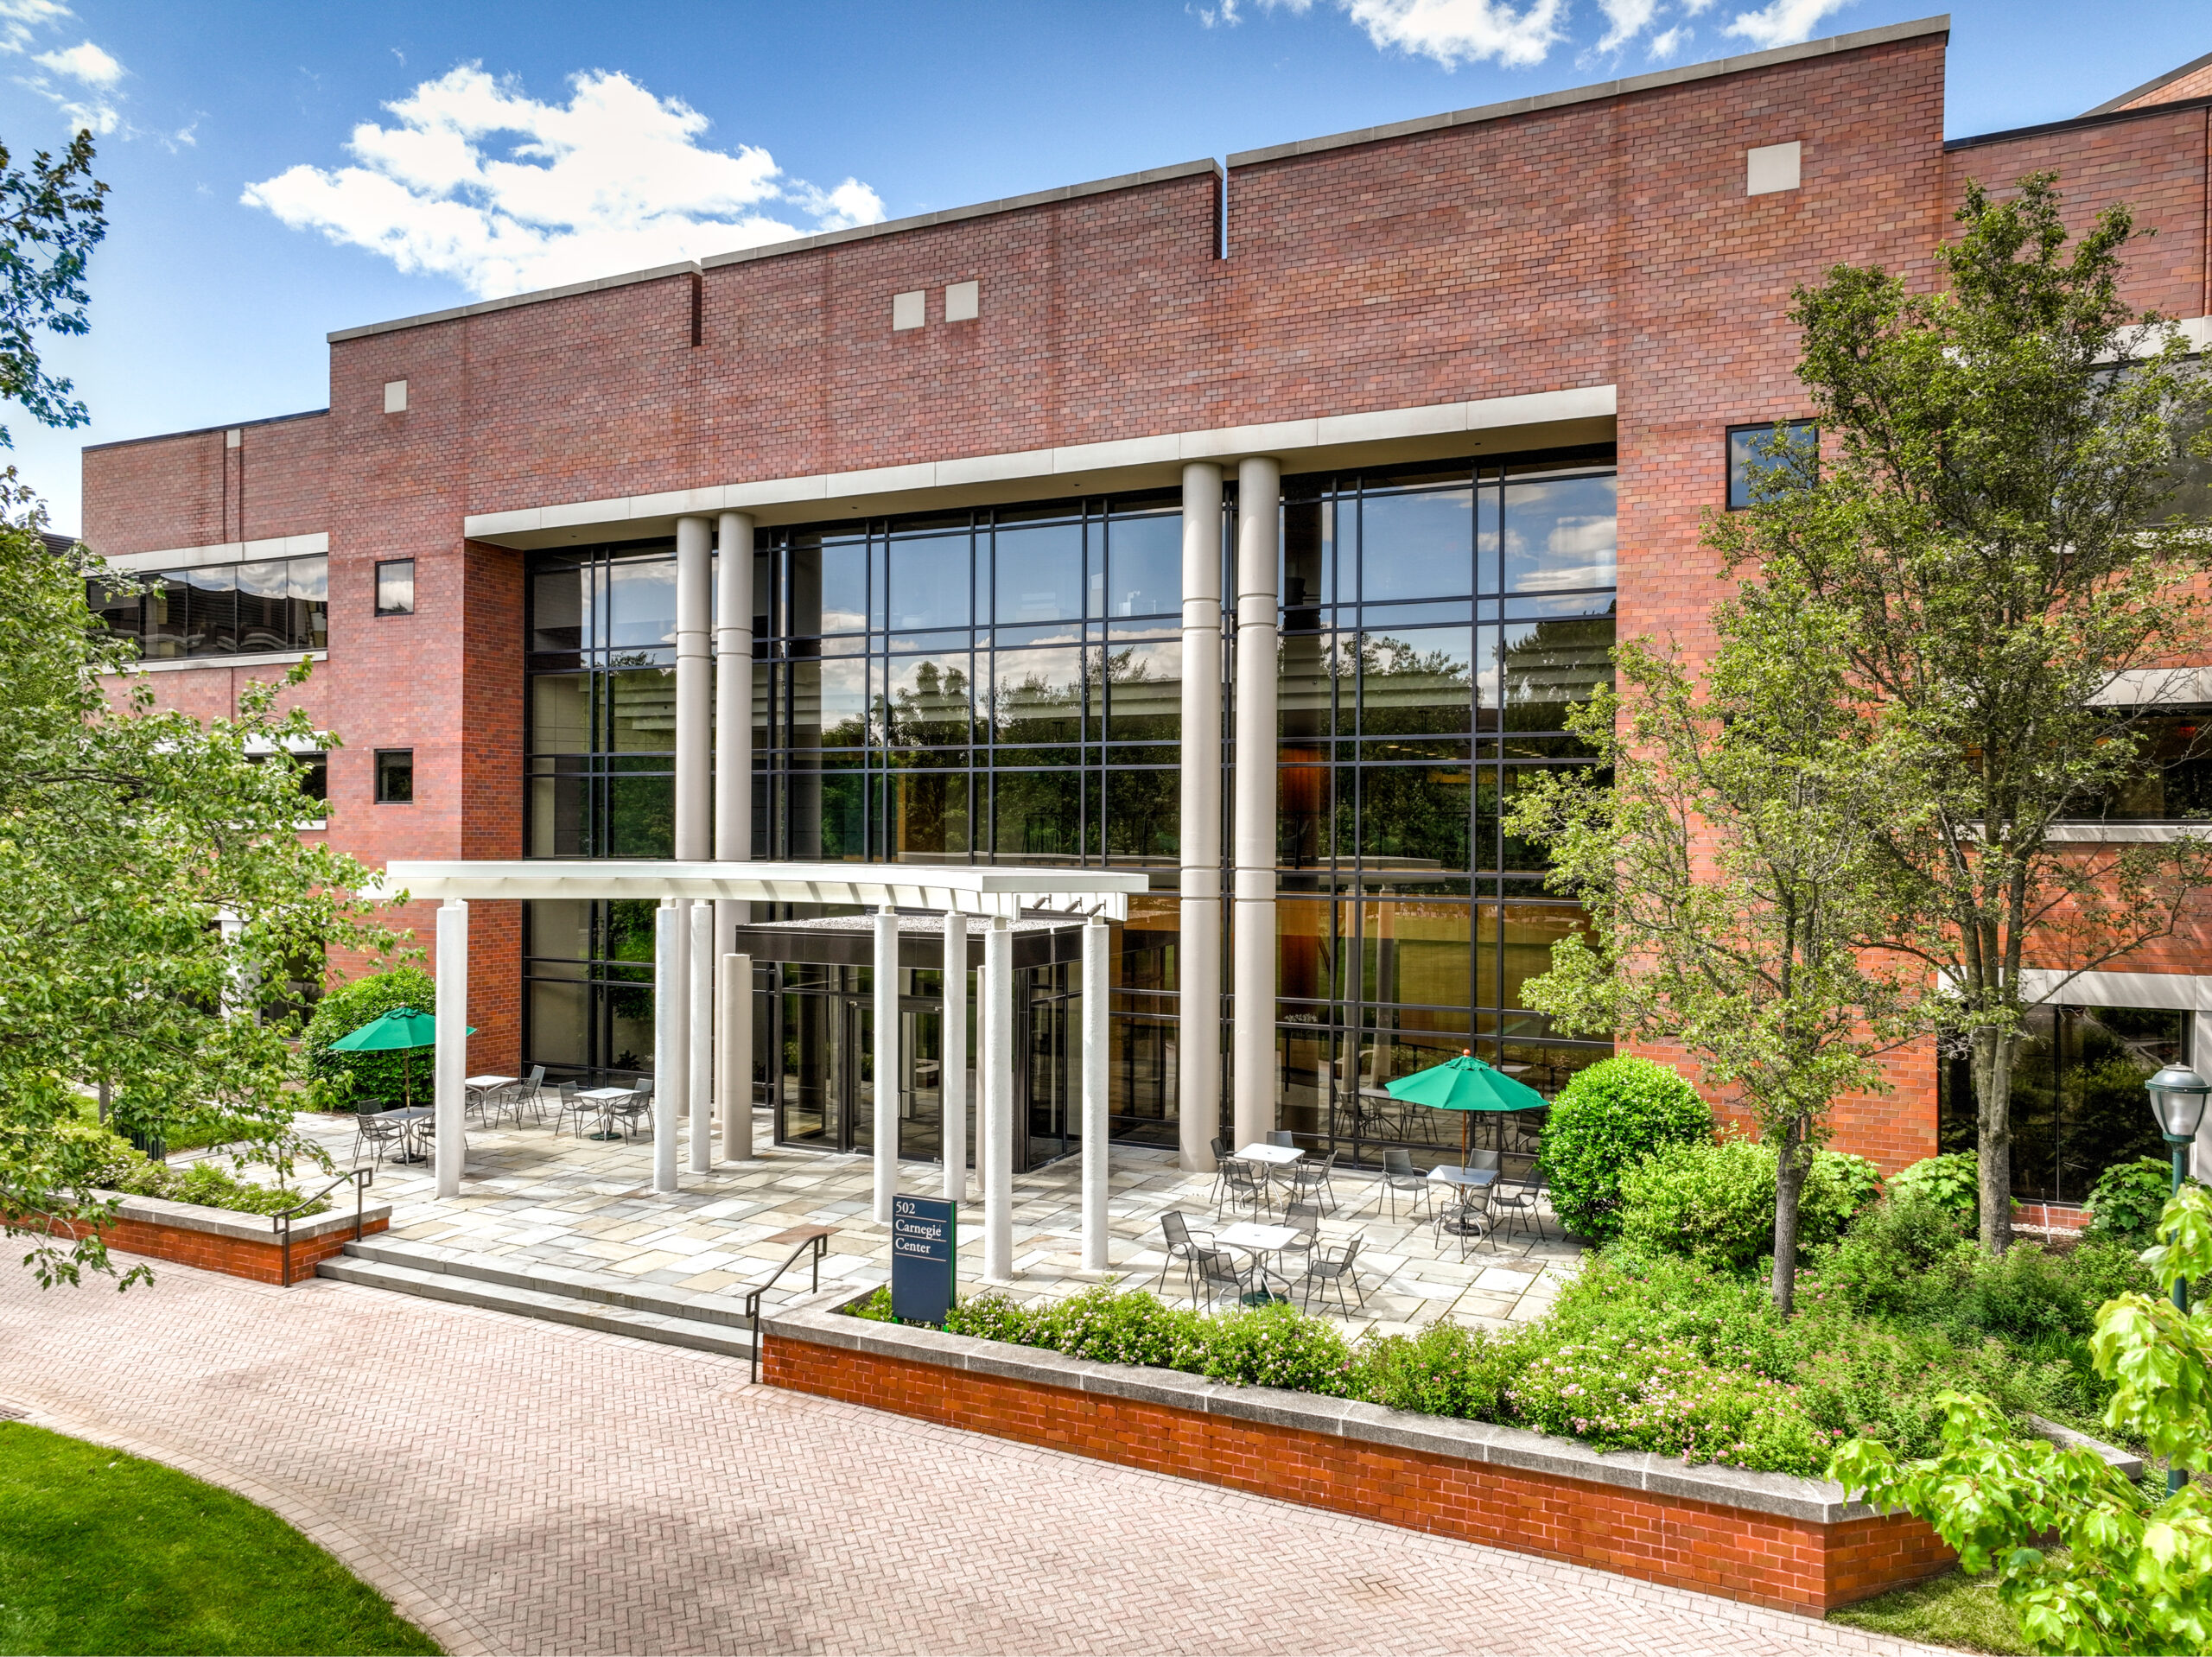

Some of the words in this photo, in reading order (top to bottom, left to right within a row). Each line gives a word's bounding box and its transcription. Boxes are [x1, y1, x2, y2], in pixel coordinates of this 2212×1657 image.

[895, 1201, 916, 1215] 502
[895, 1219, 942, 1239] Carnegie
[895, 1237, 931, 1254] Center
